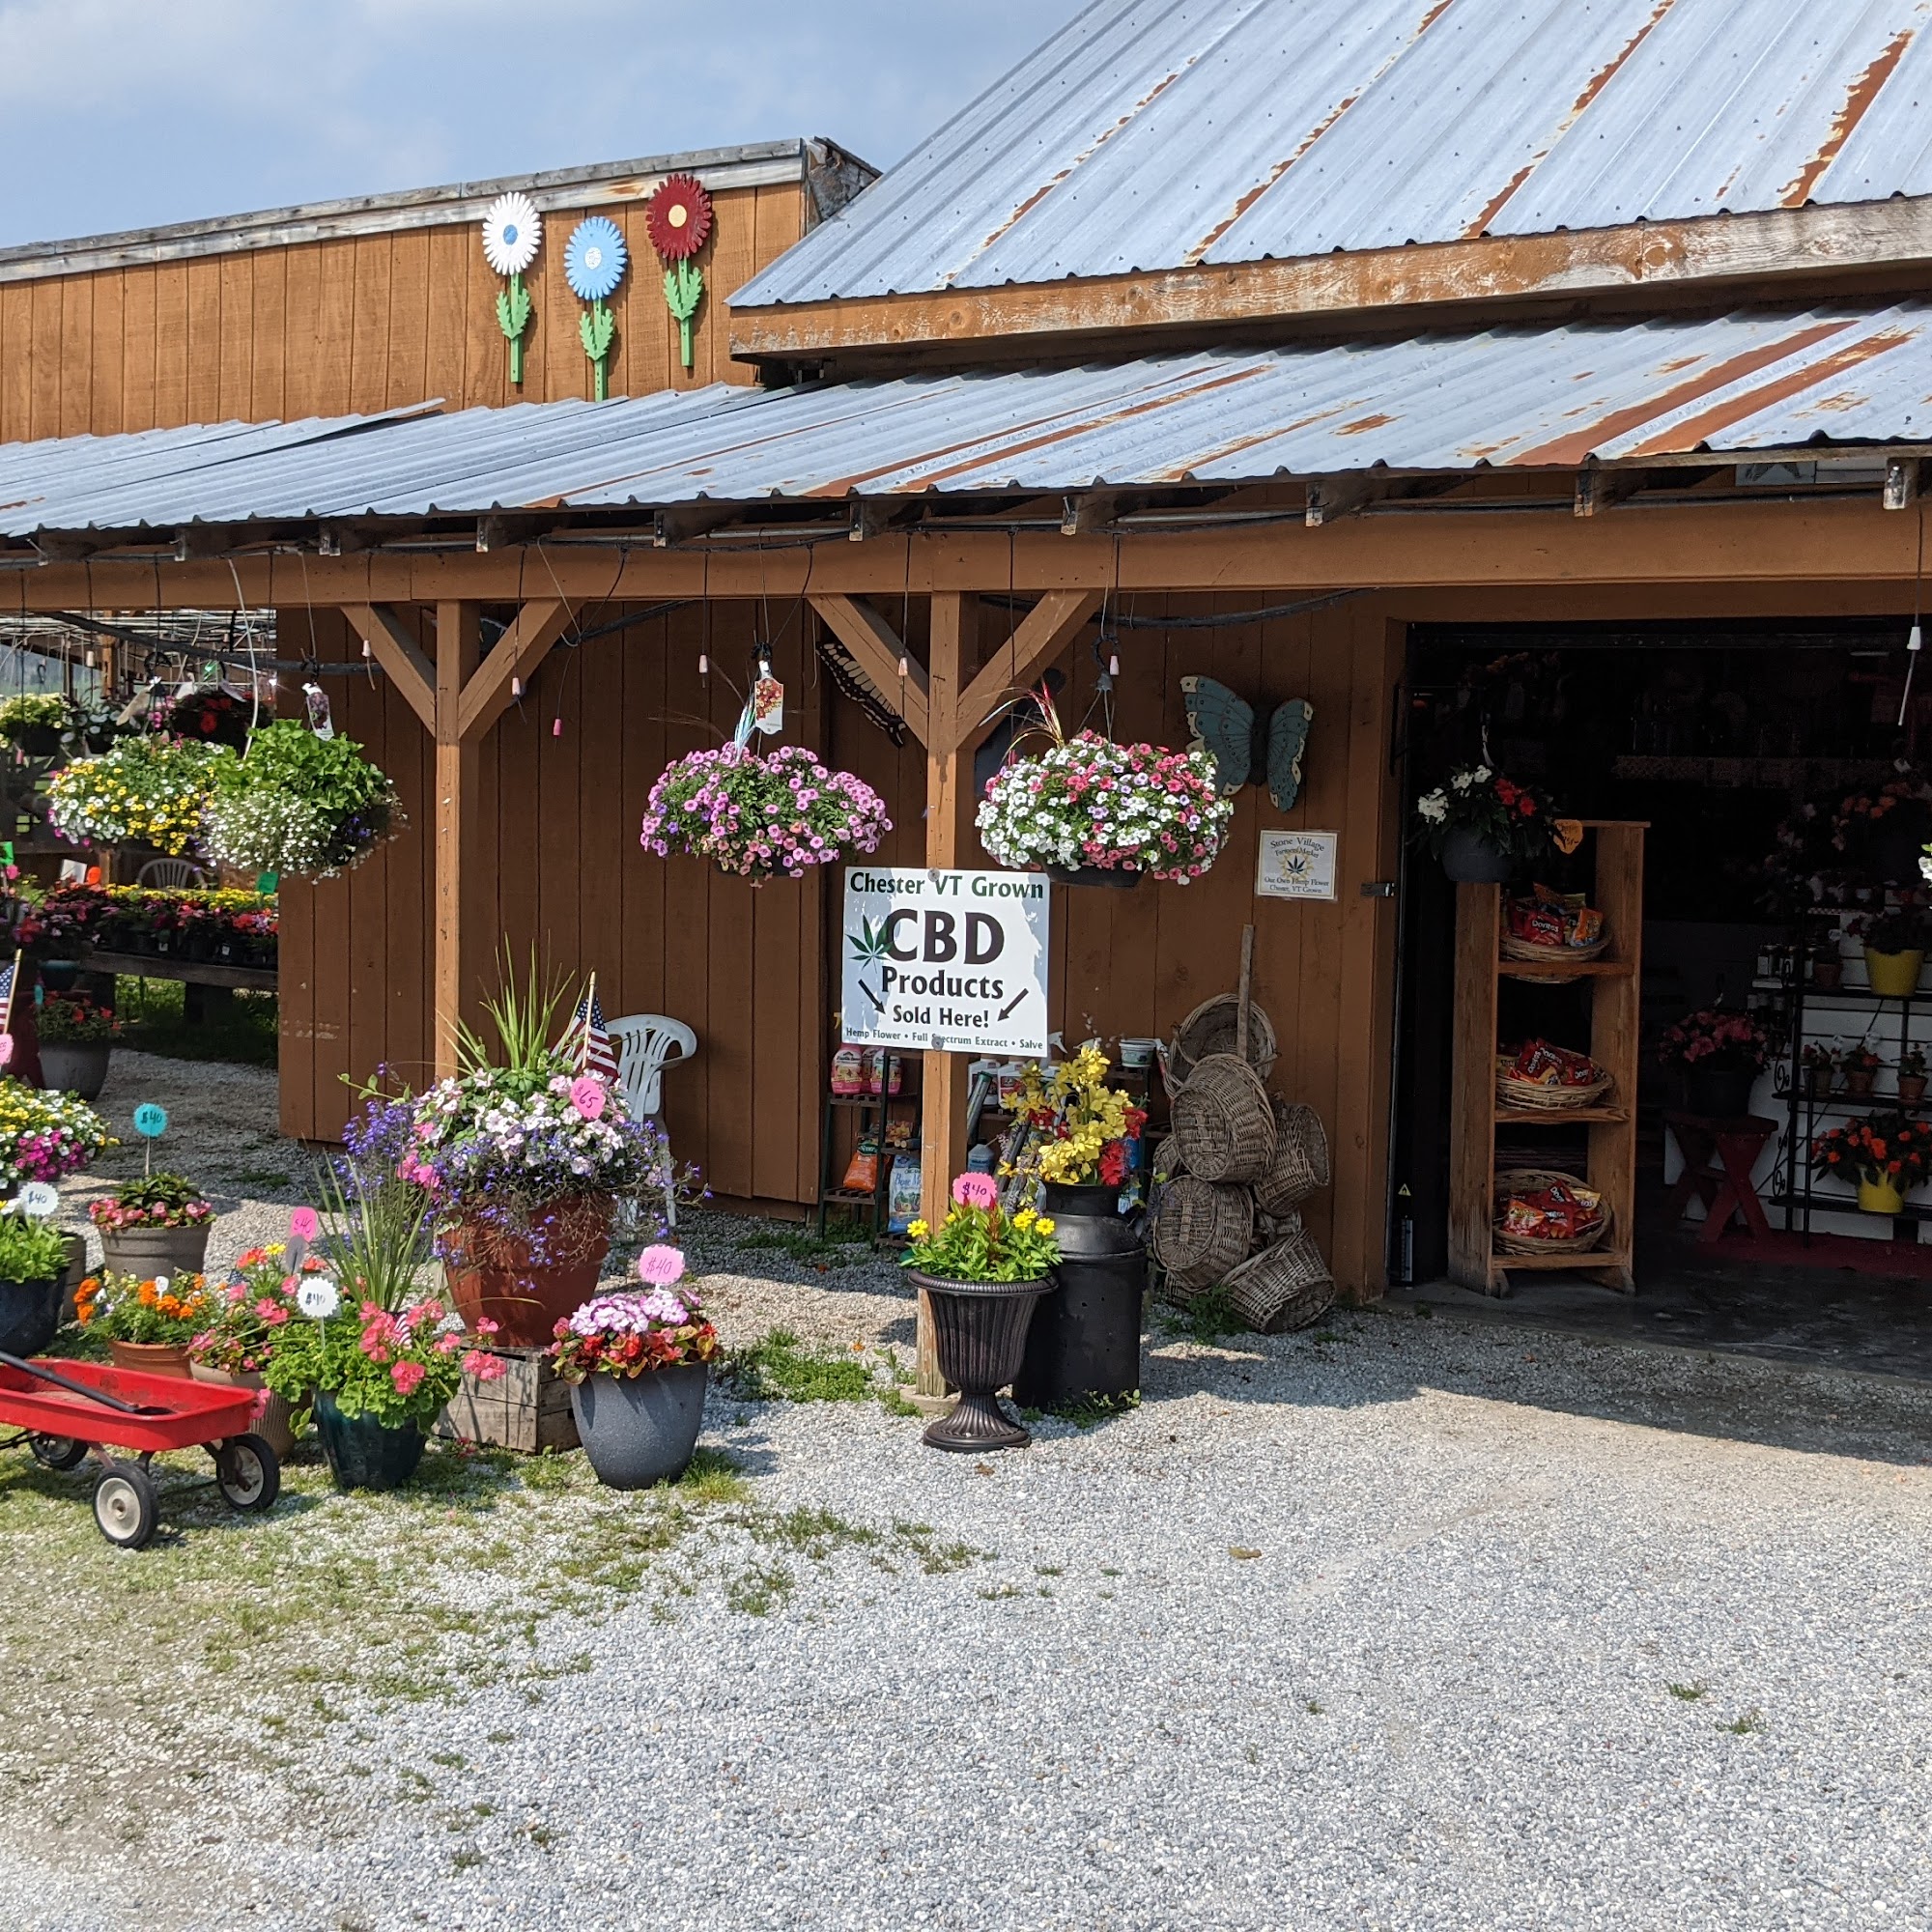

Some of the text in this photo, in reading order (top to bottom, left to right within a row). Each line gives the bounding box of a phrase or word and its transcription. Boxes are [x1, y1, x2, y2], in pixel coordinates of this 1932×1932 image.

[1270, 837, 1324, 851] Stone Village
[850, 871, 1043, 898] Chester VT Grown
[884, 908, 1005, 964] CBD
[1532, 920, 1559, 933] Doritos
[882, 966, 1004, 999] Products
[893, 1005, 989, 1028] Sold Here!
[846, 1028, 1043, 1049] Hemp Flower Full Sectrum Extract Salve
[574, 1084, 599, 1108] $65
[140, 1111, 162, 1124] $40
[28, 1190, 47, 1204] $40
[961, 1181, 987, 1196] $40
[645, 1257, 672, 1276] $40
